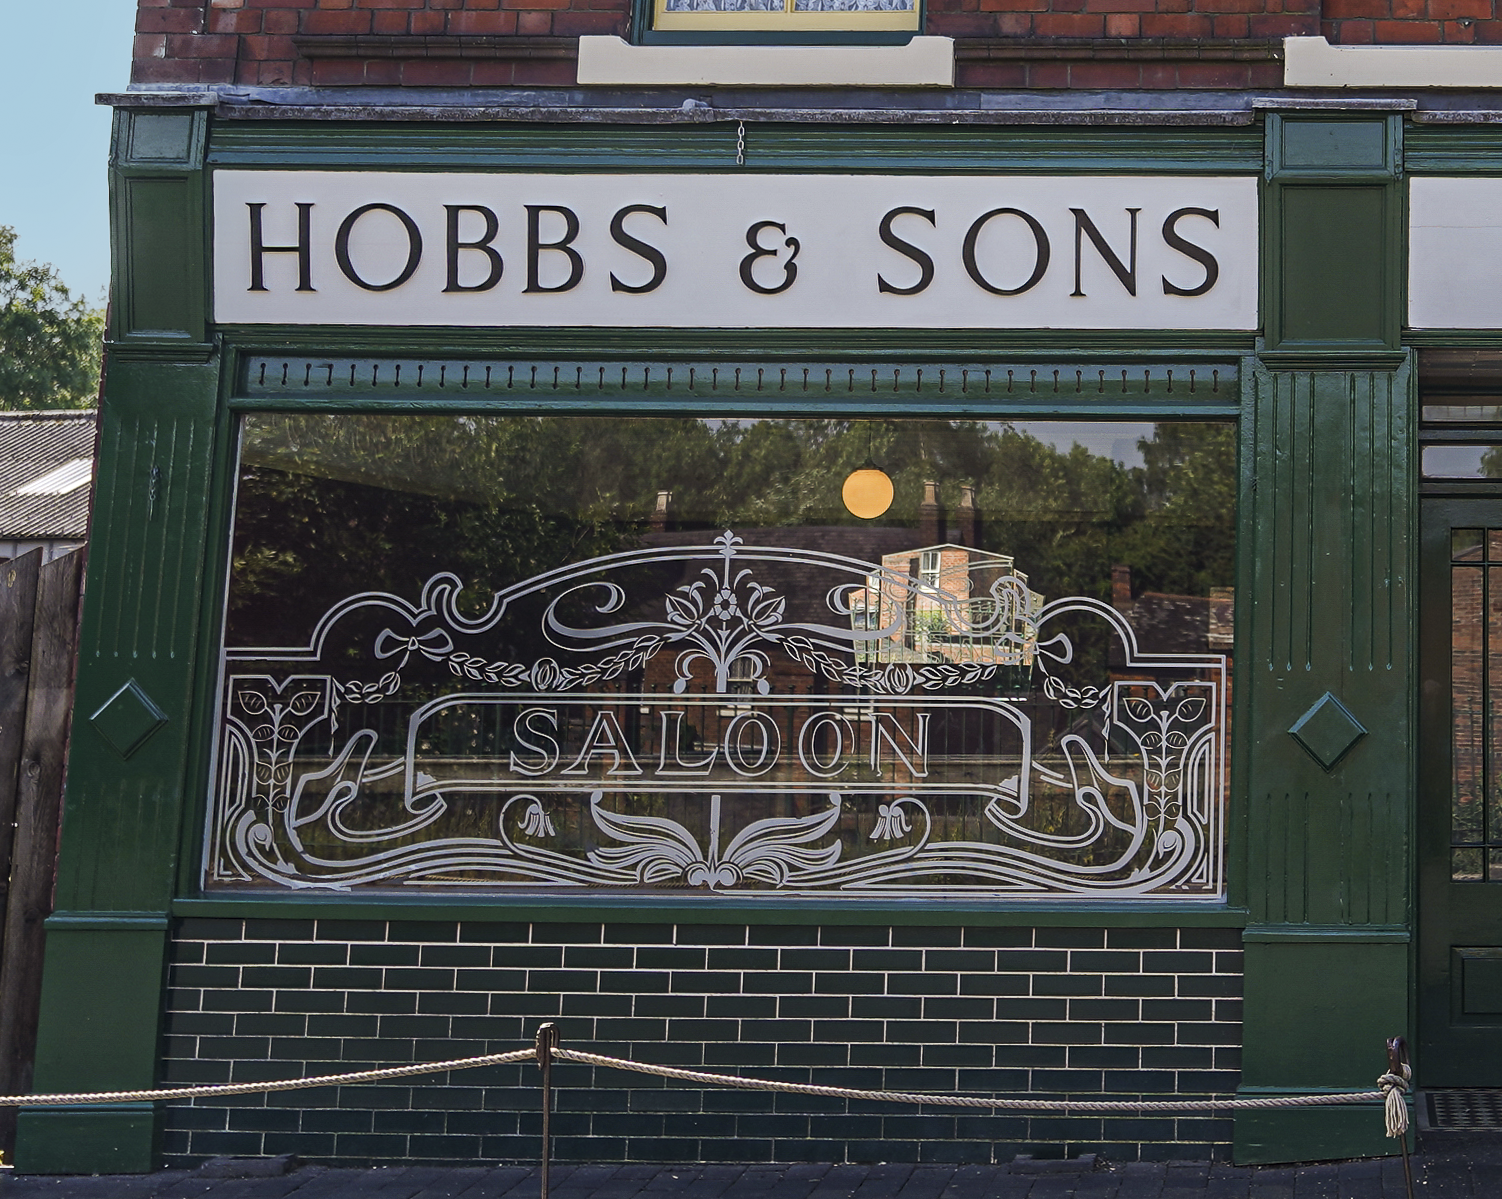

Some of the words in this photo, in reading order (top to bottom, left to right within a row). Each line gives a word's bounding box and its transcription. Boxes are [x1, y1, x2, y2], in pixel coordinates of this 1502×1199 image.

[246, 203, 667, 293] HOBBS
[740, 221, 800, 294] &
[878, 207, 1219, 296] SONS
[510, 708, 930, 778] SALOON
